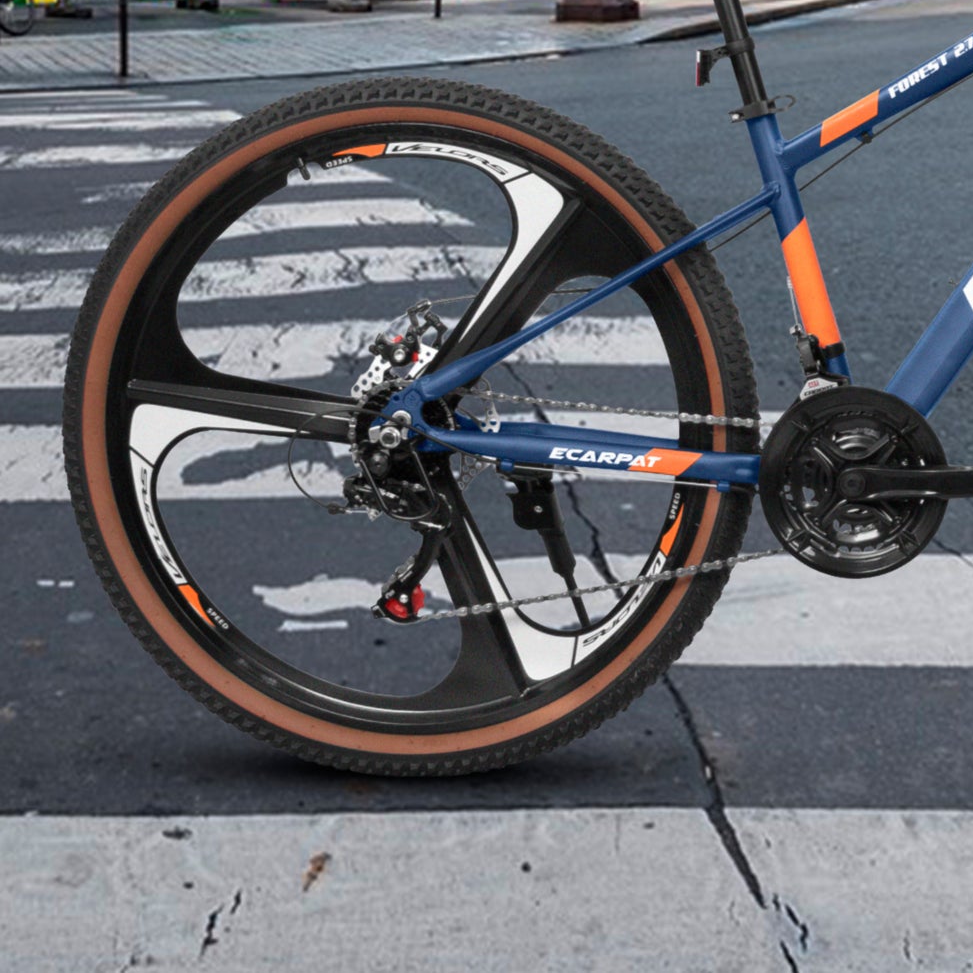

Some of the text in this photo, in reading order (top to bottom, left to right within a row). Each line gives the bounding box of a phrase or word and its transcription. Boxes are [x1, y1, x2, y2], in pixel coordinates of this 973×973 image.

[888, 52, 948, 99] FOREST
[325, 156, 353, 168] SPEED
[391, 142, 508, 176] VELORS
[549, 447, 662, 468] ECARPAT
[669, 492, 681, 520] SPEED
[141, 467, 183, 579] VELORS
[206, 607, 229, 630] SPEED
